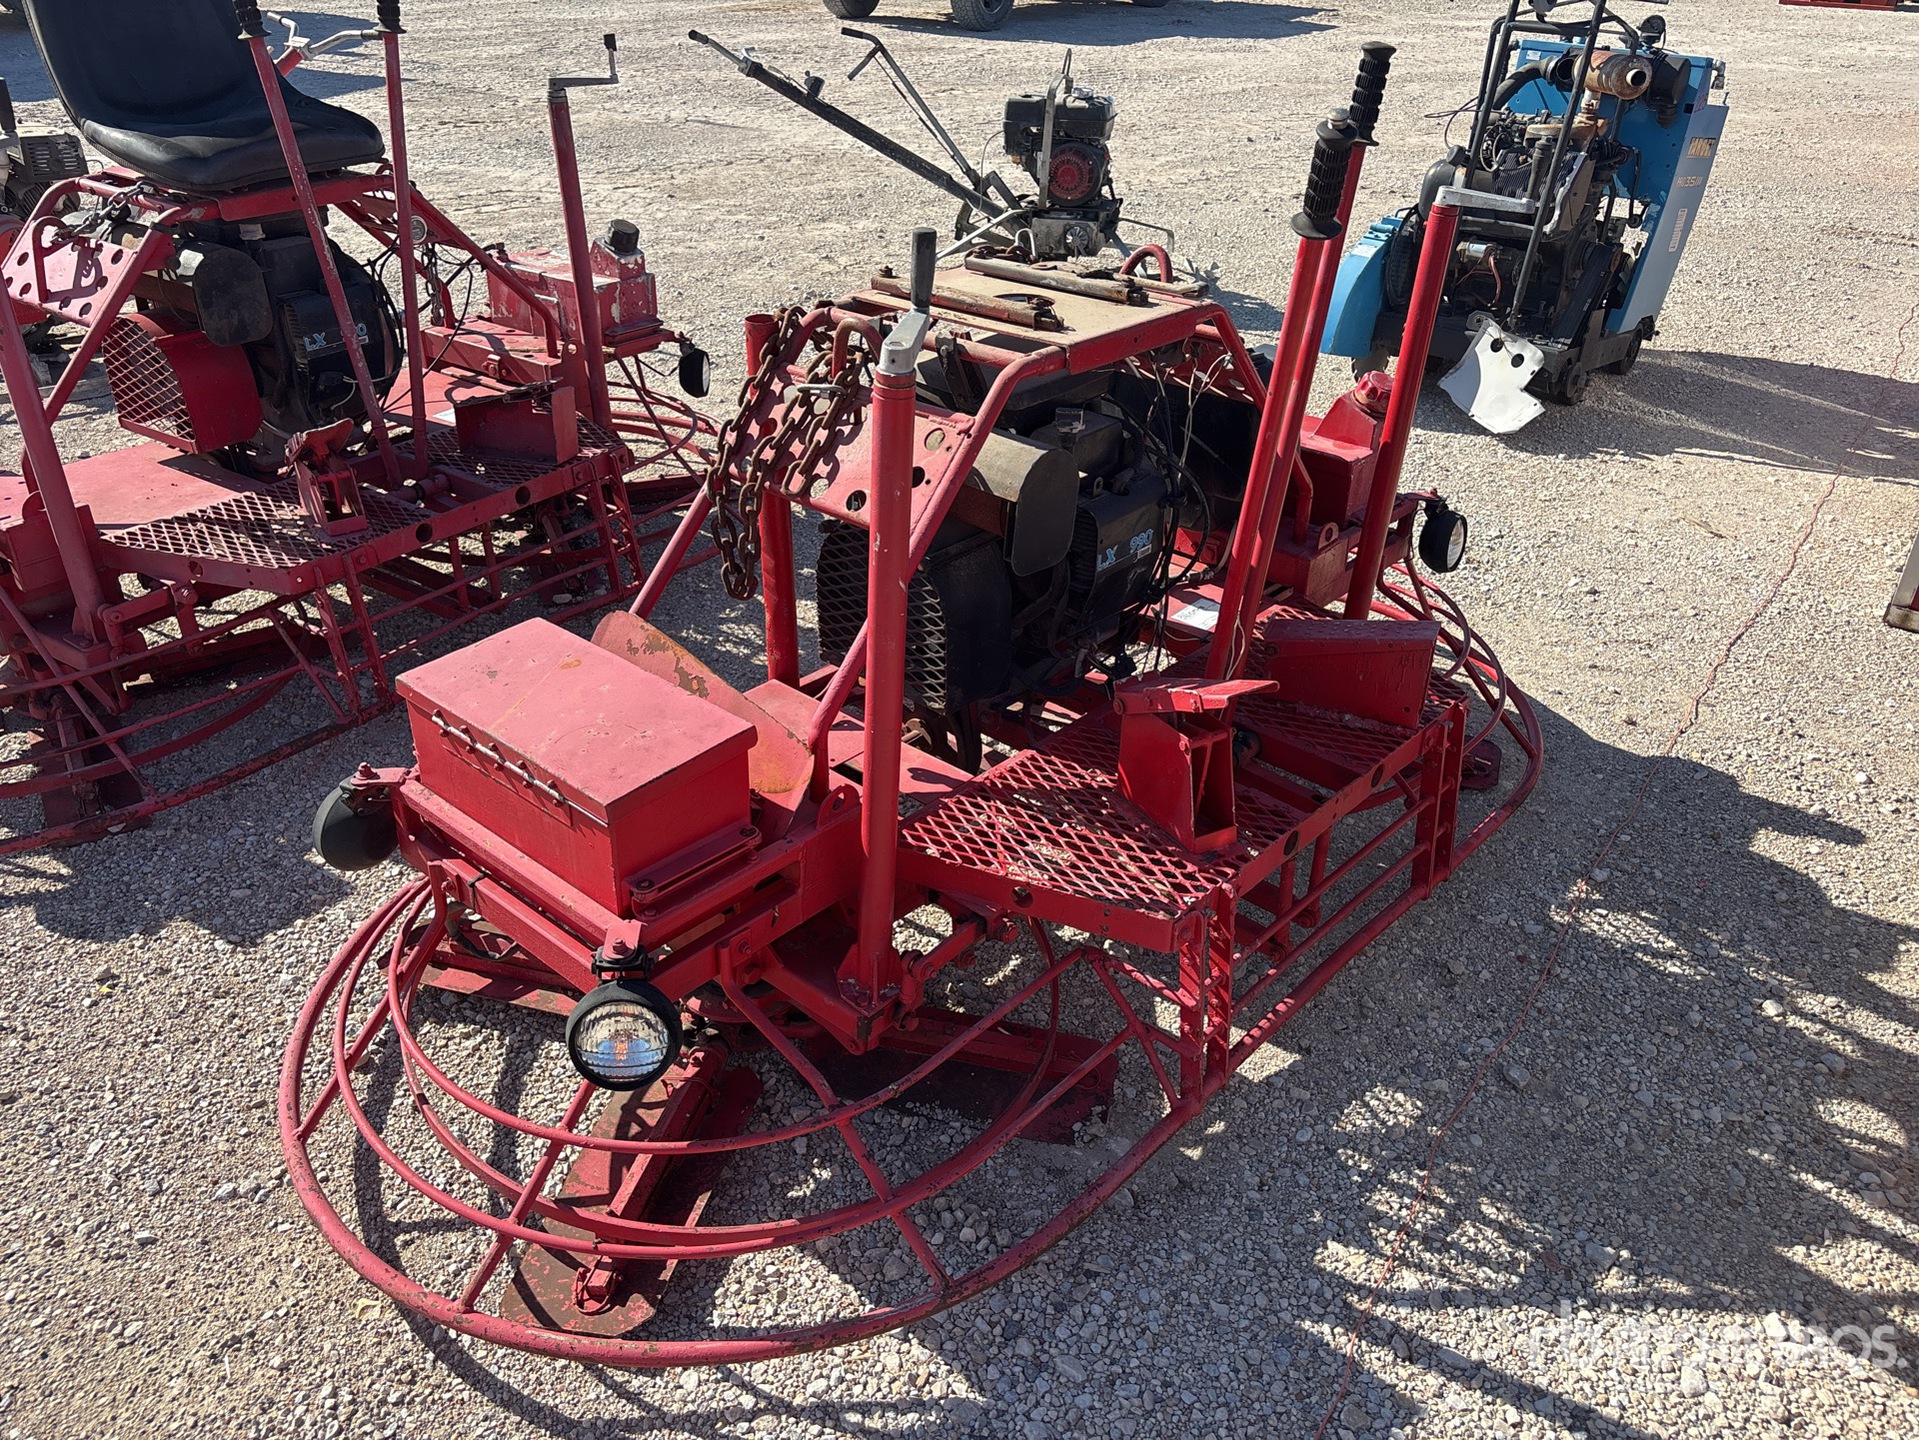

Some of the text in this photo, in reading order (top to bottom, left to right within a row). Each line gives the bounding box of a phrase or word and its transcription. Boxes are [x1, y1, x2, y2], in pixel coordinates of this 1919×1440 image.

[303, 332, 327, 352] LX
[1096, 529, 1154, 572] LX 990
